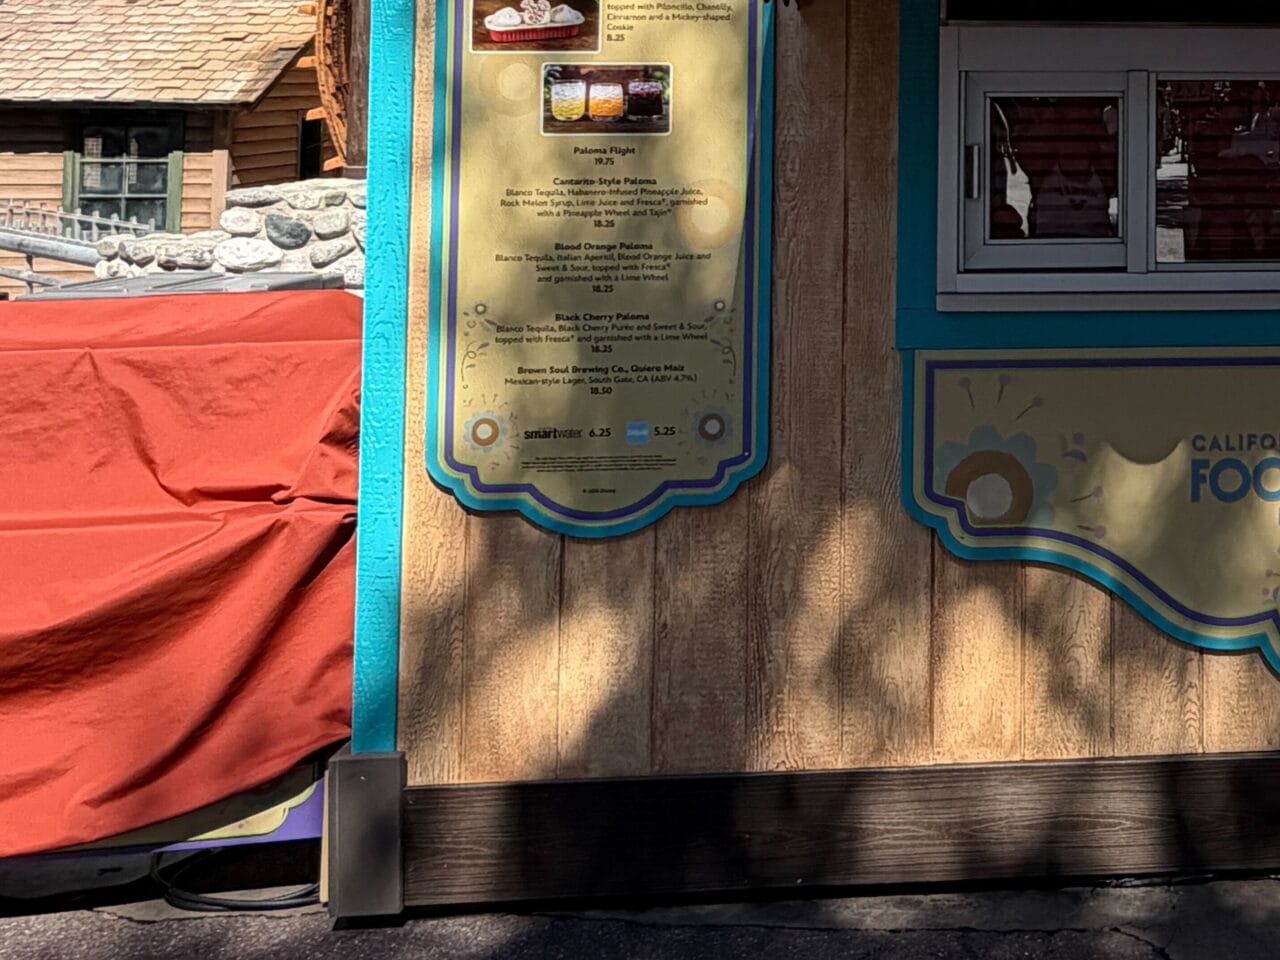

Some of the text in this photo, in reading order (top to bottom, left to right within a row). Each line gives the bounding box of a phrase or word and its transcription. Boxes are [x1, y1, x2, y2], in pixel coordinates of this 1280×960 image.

[637, 3, 655, 11] with
[648, 13, 664, 21] and
[671, 13, 731, 22] Mickey-shaped
[573, 147, 636, 156] Paloma Flight
[594, 158, 614, 166] 19.75
[553, 177, 657, 187] Cantarito-Style Paloma
[535, 189, 566, 198] Tequila,
[620, 198, 634, 206] and
[537, 209, 554, 217] with
[563, 209, 602, 218] Pineapple
[594, 220, 615, 228] 18.25
[584, 243, 617, 252] Orange
[495, 254, 523, 262] Blanco
[525, 254, 555, 263] Tequila,
[617, 253, 641, 261] Blood
[643, 253, 673, 262] Orange
[696, 252, 711, 260] and
[536, 264, 559, 272] Sweet
[592, 264, 620, 273] topped
[622, 263, 640, 271] with
[537, 275, 552, 283] and
[554, 275, 593, 284] garnished
[595, 274, 612, 282] with
[592, 285, 614, 293] 18.25
[555, 313, 580, 321] Black
[583, 313, 613, 322] Cherry
[496, 325, 524, 333] Blanco
[526, 324, 557, 334] Tequila,
[558, 324, 580, 332] Black
[582, 324, 609, 333] Cherry
[636, 323, 651, 331] and
[653, 323, 677, 331] Sweet
[687, 323, 708, 331] Sour,
[495, 336, 524, 345] topped
[526, 335, 543, 343] with
[576, 334, 592, 342] and
[594, 334, 633, 343] garnished
[661, 333, 680, 341] Lime
[591, 345, 613, 353] 18.25
[517, 366, 547, 374] Brown
[571, 366, 609, 375] Brewing
[611, 365, 629, 373] Co.,
[504, 377, 560, 386] Mexican-style
[562, 376, 587, 385] Lager,
[613, 375, 635, 384] Gate,
[651, 374, 672, 383] (ABV
[524, 428, 583, 439] smartwater
[589, 427, 611, 438] 6.25
[654, 426, 676, 436] 5.25
